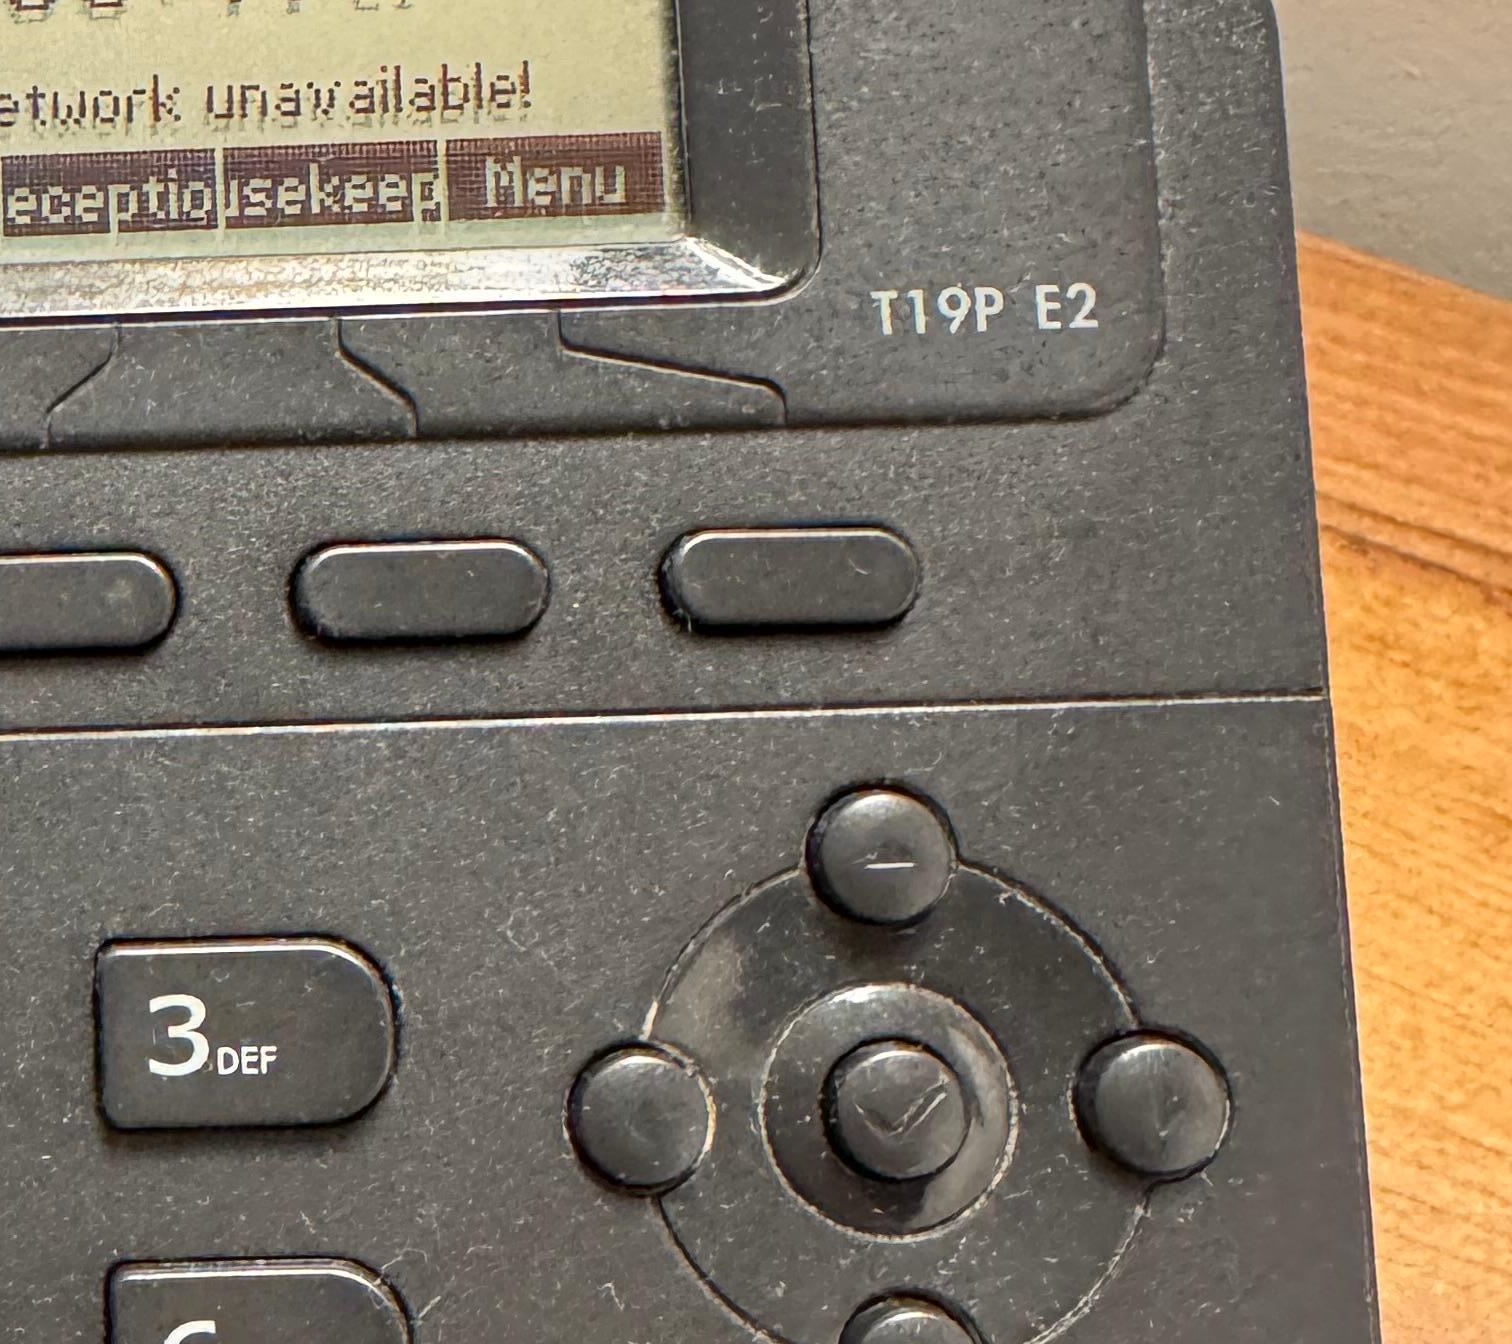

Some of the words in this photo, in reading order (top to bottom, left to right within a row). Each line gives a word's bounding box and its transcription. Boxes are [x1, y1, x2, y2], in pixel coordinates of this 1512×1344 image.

[206, 60, 532, 119] unavailable!
[487, 155, 626, 209] Menu
[870, 286, 1005, 335] T19P
[1036, 282, 1099, 330] E2
[148, 994, 210, 1076] 3
[217, 1045, 278, 1075] DEF
